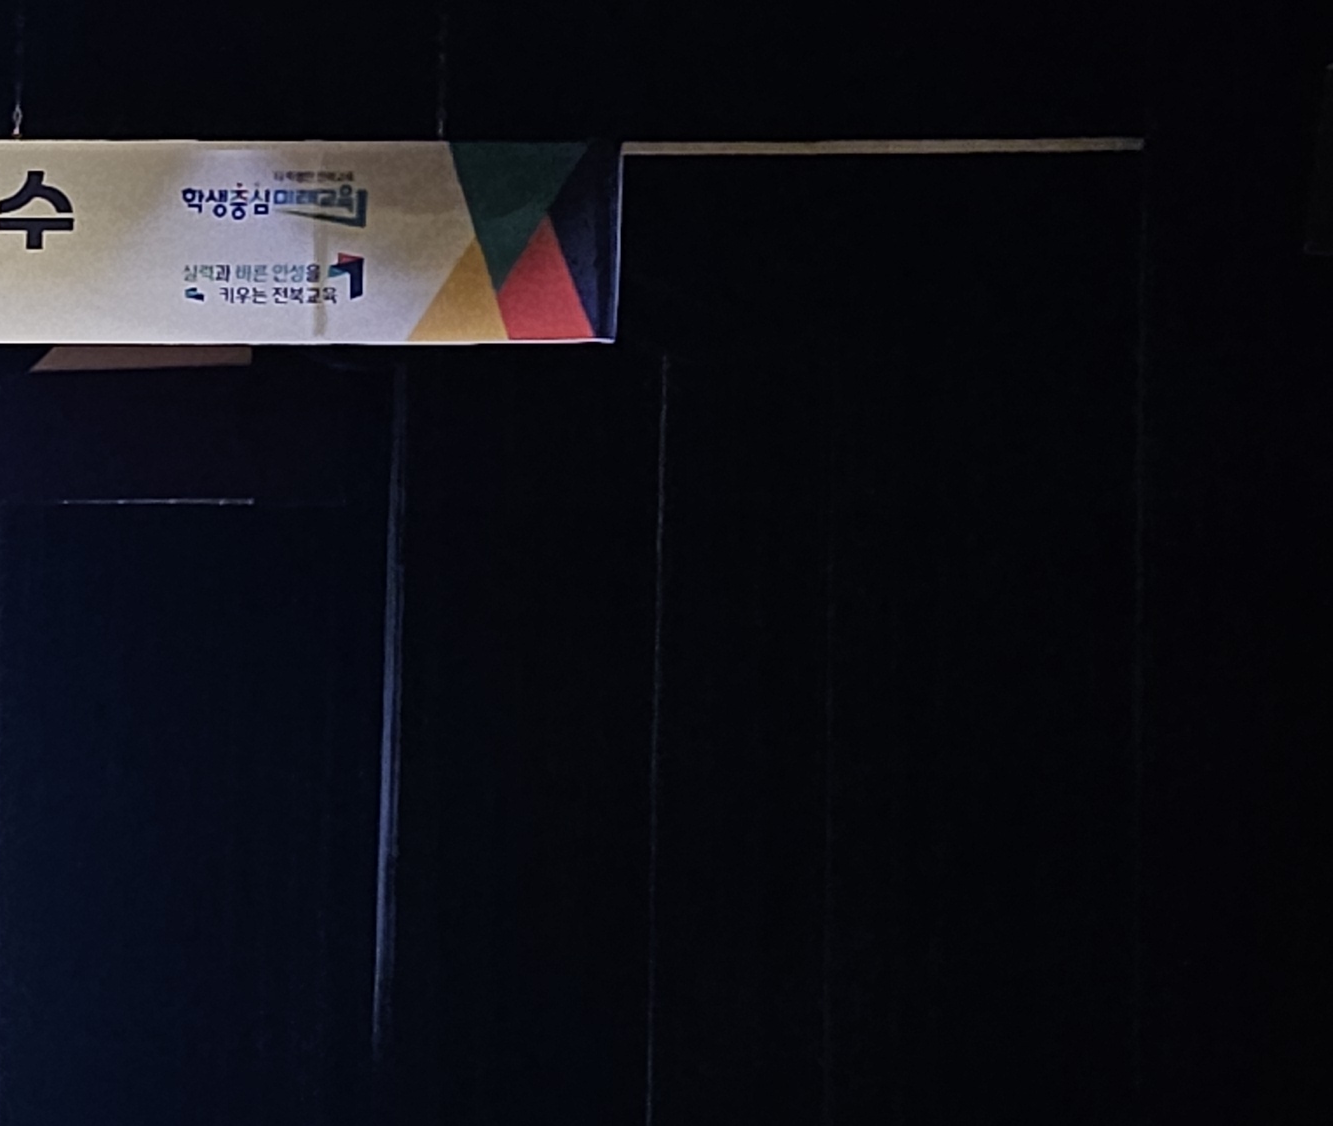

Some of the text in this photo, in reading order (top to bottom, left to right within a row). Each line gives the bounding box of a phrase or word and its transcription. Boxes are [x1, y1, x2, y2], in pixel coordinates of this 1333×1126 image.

[182, 183, 270, 220] 학생중심
[236, 265, 267, 282] 바른
[274, 264, 321, 282] 인성을
[220, 287, 336, 304] 키우는 전북교육
